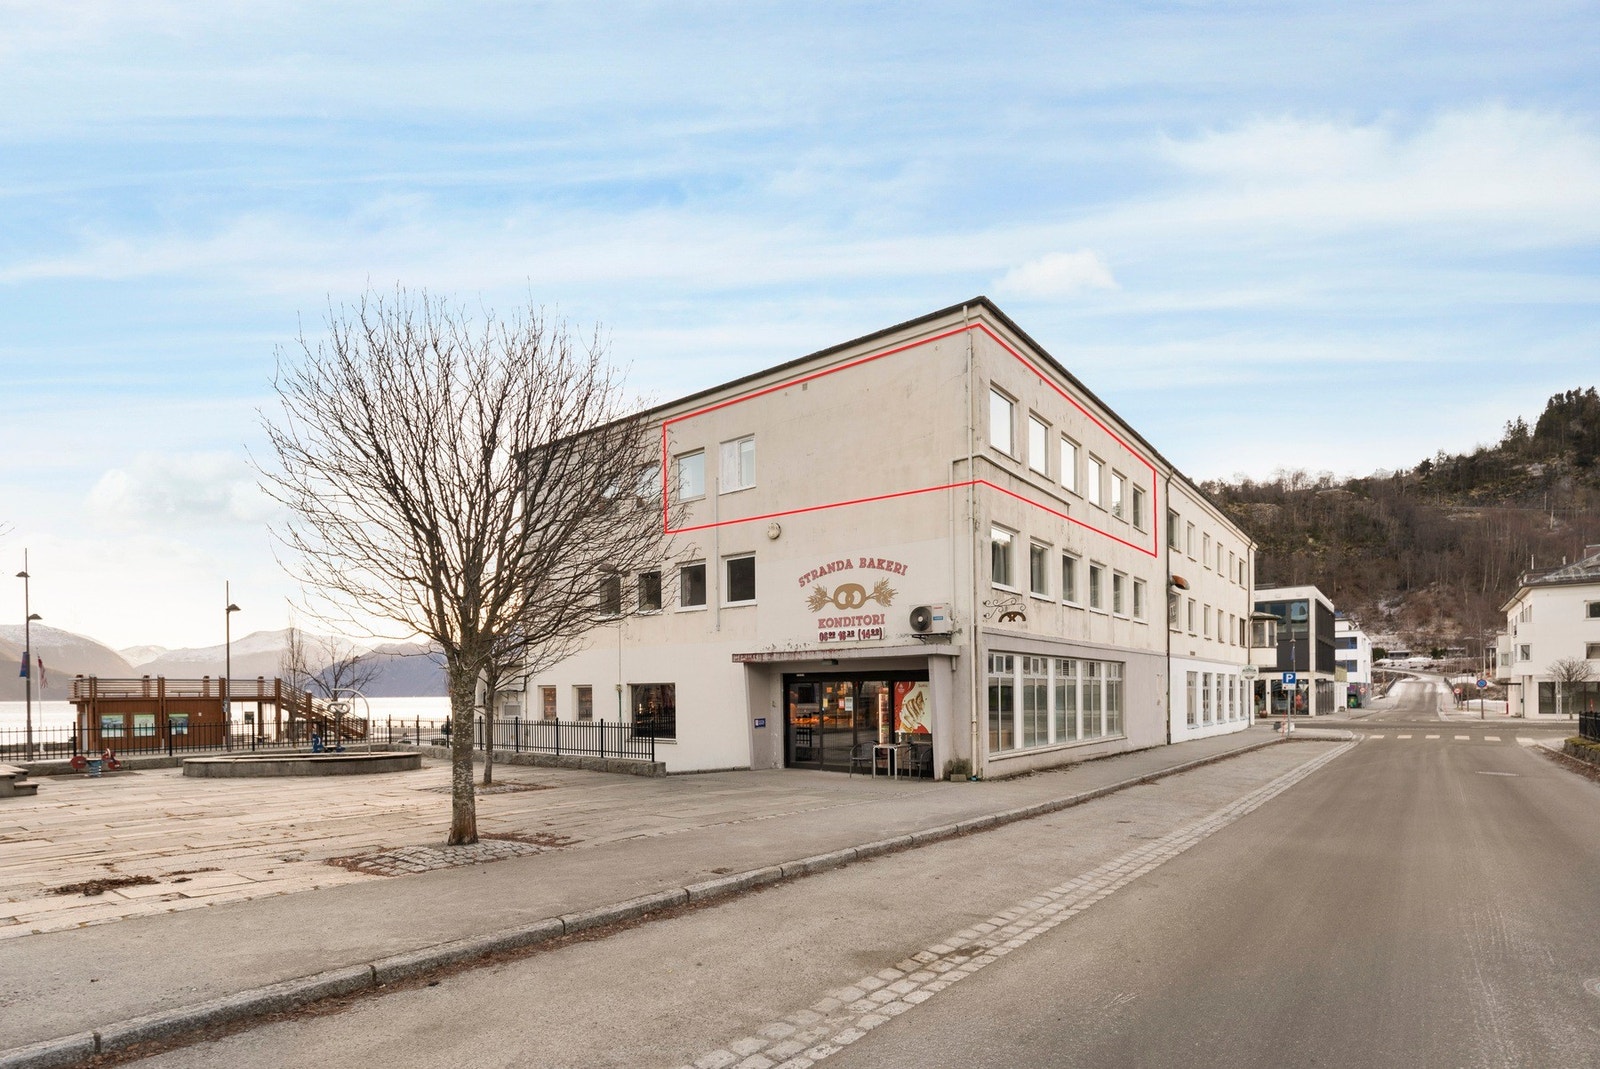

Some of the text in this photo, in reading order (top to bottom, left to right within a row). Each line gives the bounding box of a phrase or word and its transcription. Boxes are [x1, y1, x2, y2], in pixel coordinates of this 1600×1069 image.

[798, 557, 908, 588] STRANDA BAKERI
[817, 613, 885, 629] KONDITORI
